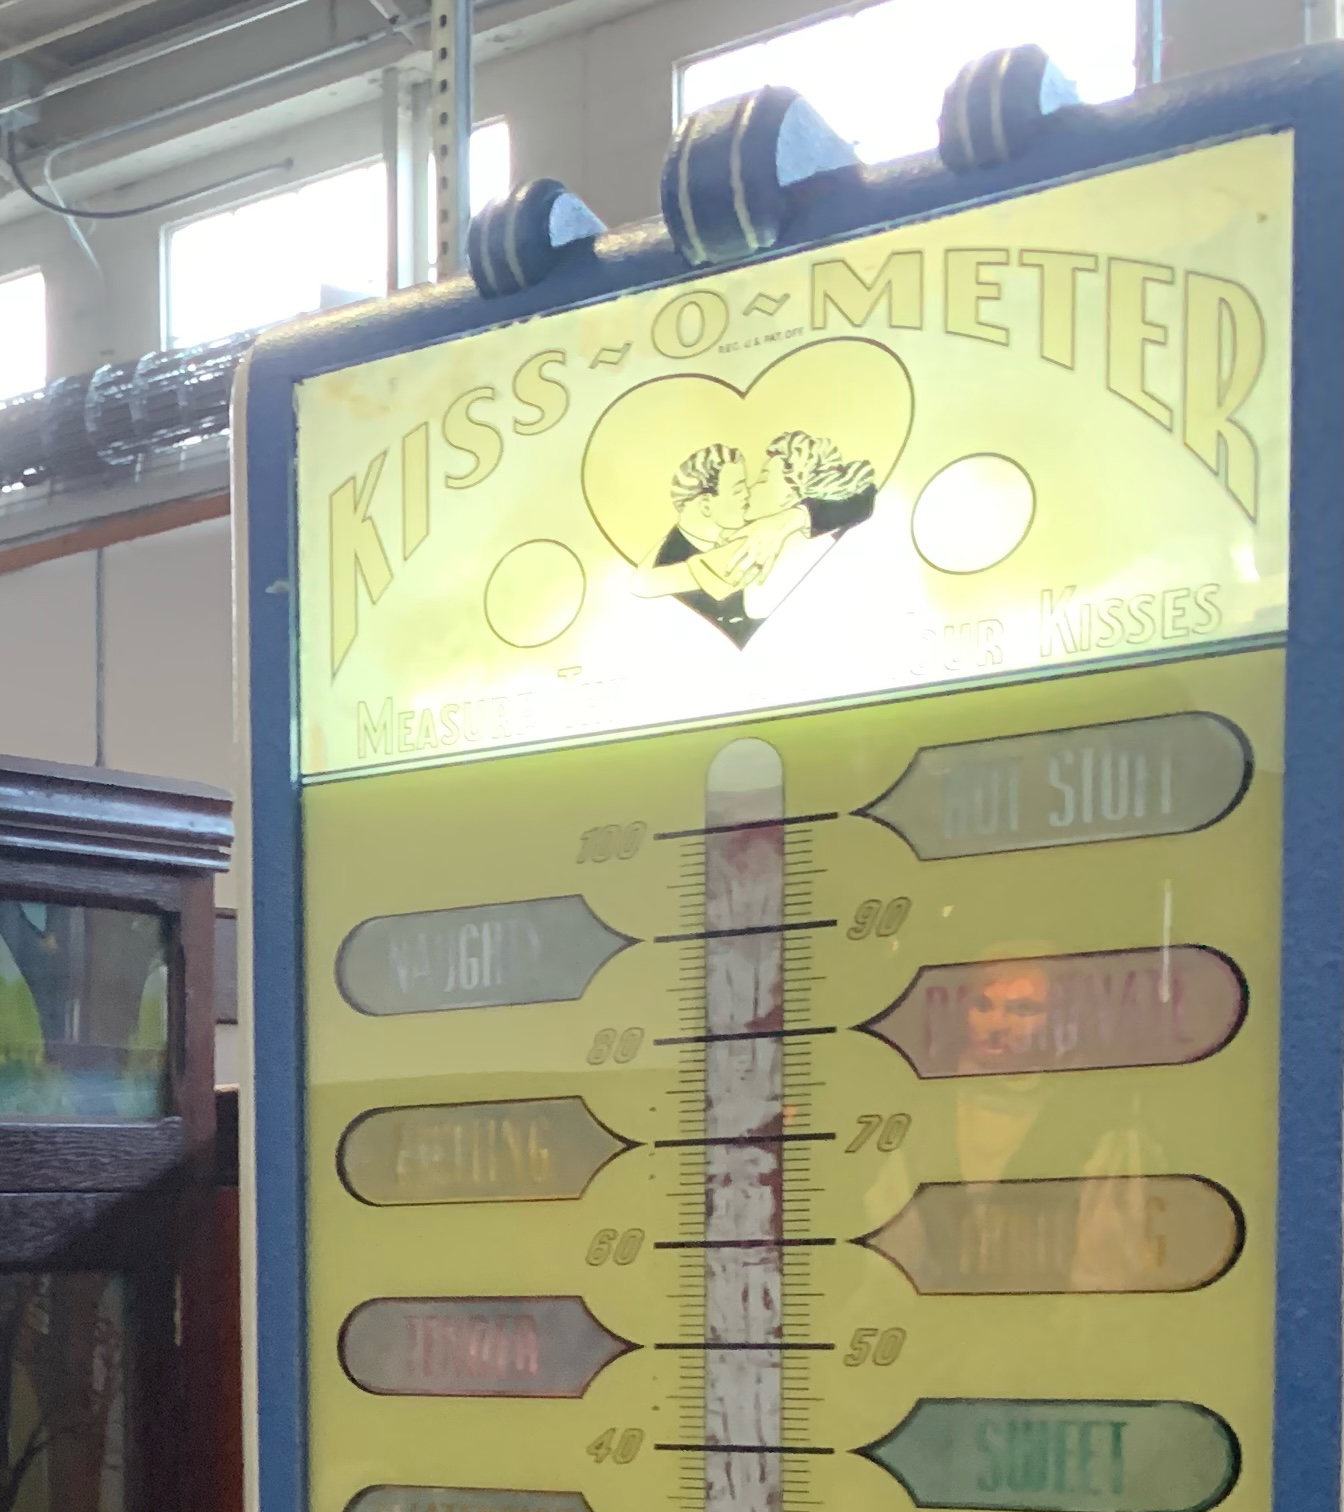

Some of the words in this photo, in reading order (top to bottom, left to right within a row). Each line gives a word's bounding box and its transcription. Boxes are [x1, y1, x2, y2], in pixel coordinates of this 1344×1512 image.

[1039, 583, 1223, 658] KISSES
[577, 821, 647, 865] 100
[846, 897, 912, 941] 90
[587, 1026, 645, 1066] 80
[844, 1113, 912, 1155] 70
[586, 1228, 645, 1267] 60
[843, 1326, 908, 1367] 50
[586, 1427, 645, 1465] 40
